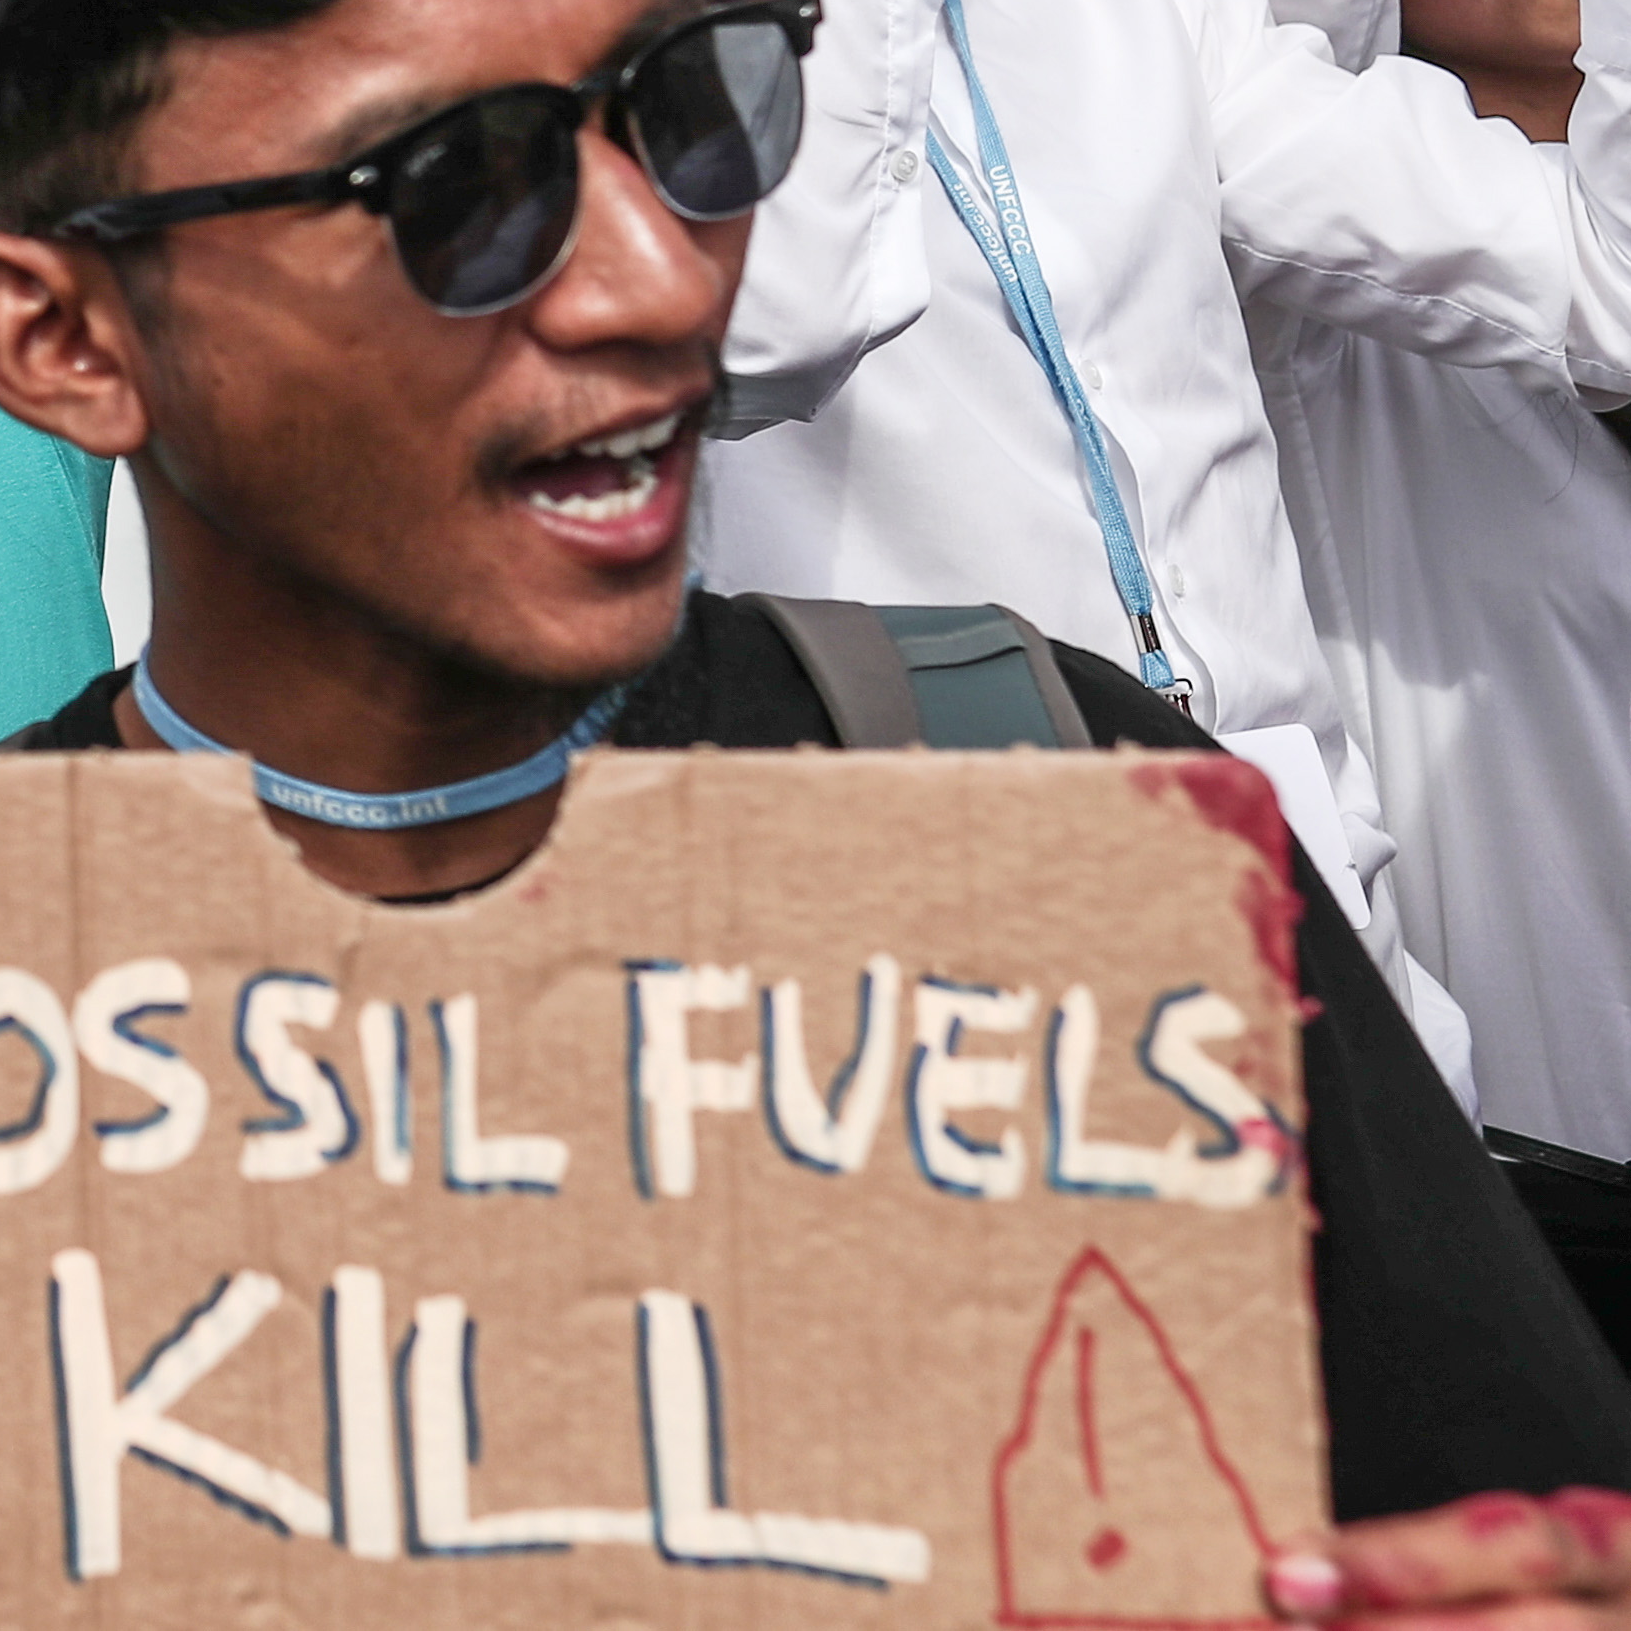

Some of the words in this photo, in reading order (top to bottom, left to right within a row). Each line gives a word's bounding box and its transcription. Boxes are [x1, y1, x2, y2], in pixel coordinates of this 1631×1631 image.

[954, 183, 1018, 283] unfccc.int
[989, 165, 1031, 255] UNFCCC
[272, 782, 448, 824] unfccc.int
[621, 952, 1297, 1209] FUELS
[47, 1246, 932, 1583] KILL
